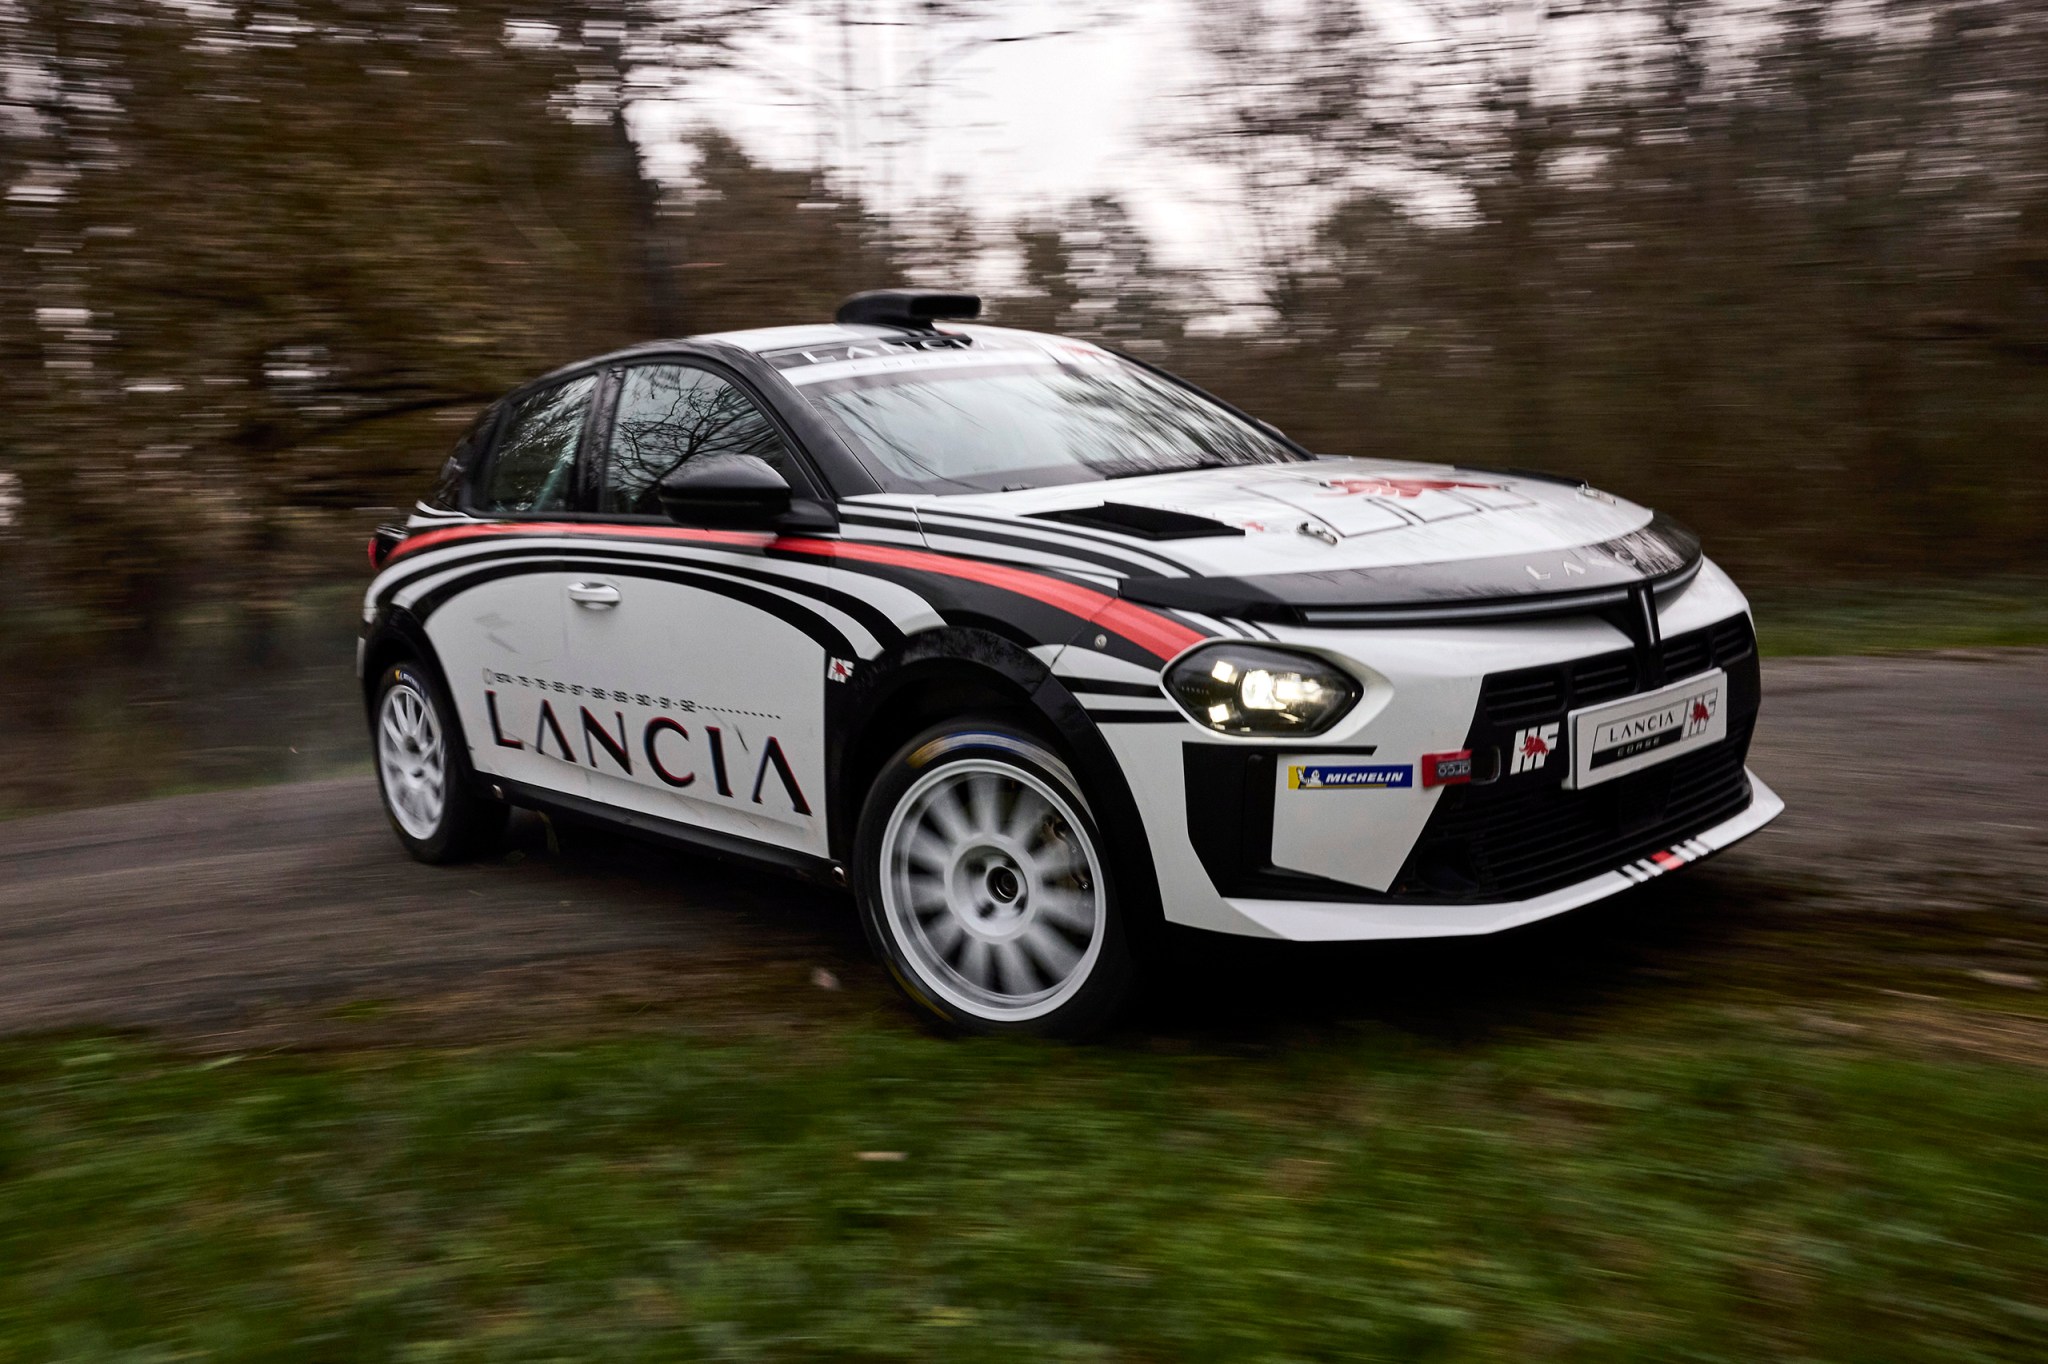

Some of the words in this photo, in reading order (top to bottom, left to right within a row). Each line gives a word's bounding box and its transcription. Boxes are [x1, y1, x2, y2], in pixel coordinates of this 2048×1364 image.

[1608, 710, 1674, 742] LANCIA
[484, 689, 813, 817] LANCIA
[1325, 772, 1404, 783] MICHELIN
